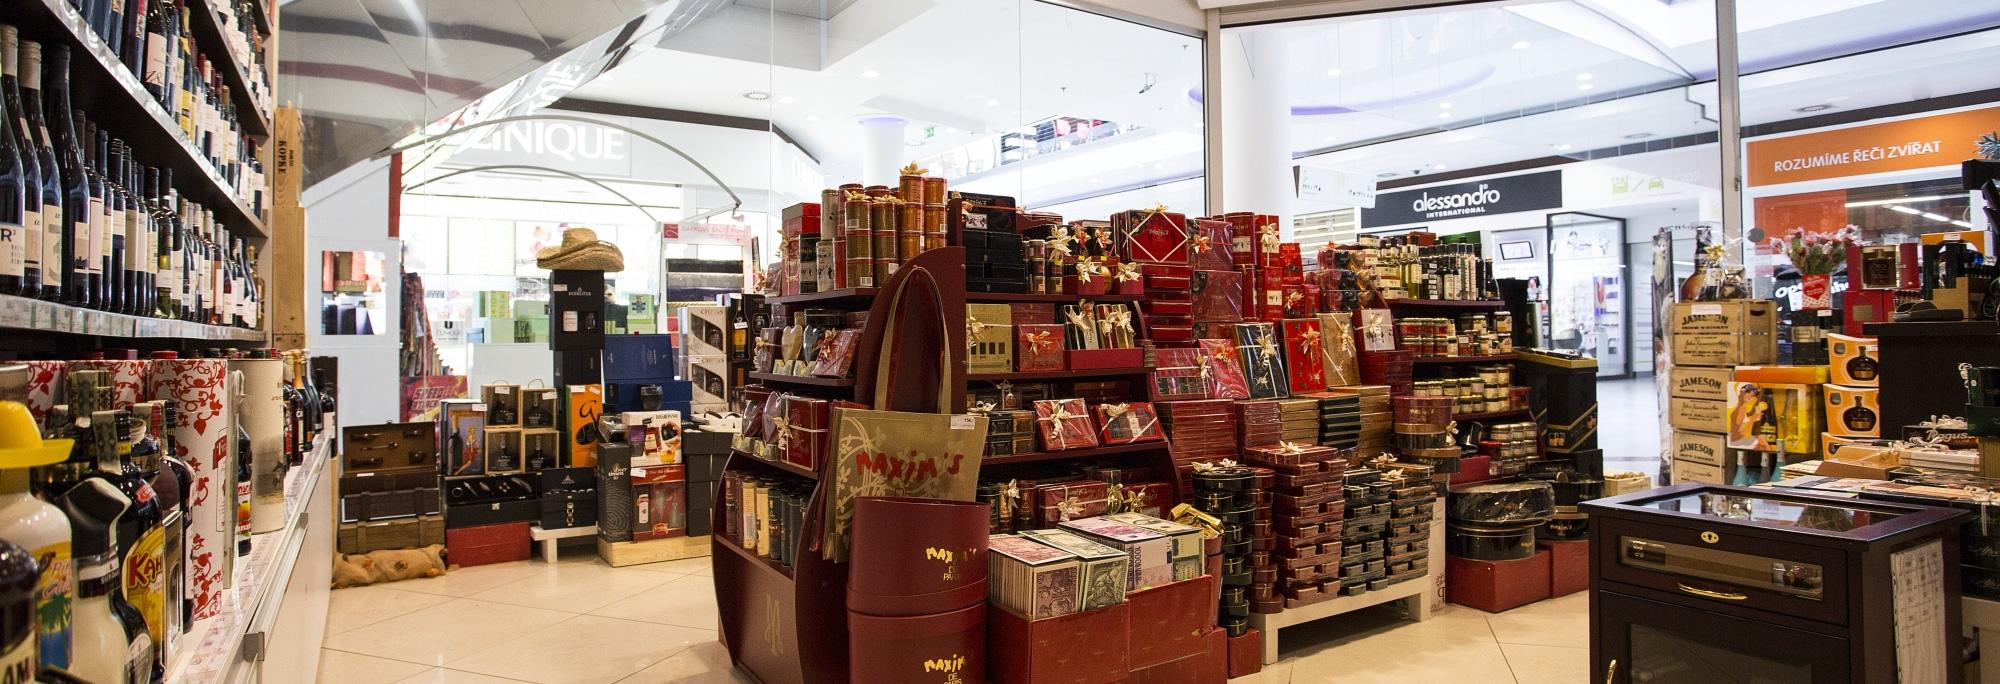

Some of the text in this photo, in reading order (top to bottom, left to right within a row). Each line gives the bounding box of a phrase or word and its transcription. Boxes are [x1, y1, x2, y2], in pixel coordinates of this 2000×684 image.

[458, 120, 625, 162] LINIQUE
[1774, 140, 1942, 173] ROZUMÍME ŘEČI ZVÍŘAT
[1413, 184, 1500, 213] alessandro
[1426, 206, 1486, 219] INTERNATIONAL
[1680, 376, 1722, 391] JAMESON
[1680, 443, 1714, 457] JAMESON
